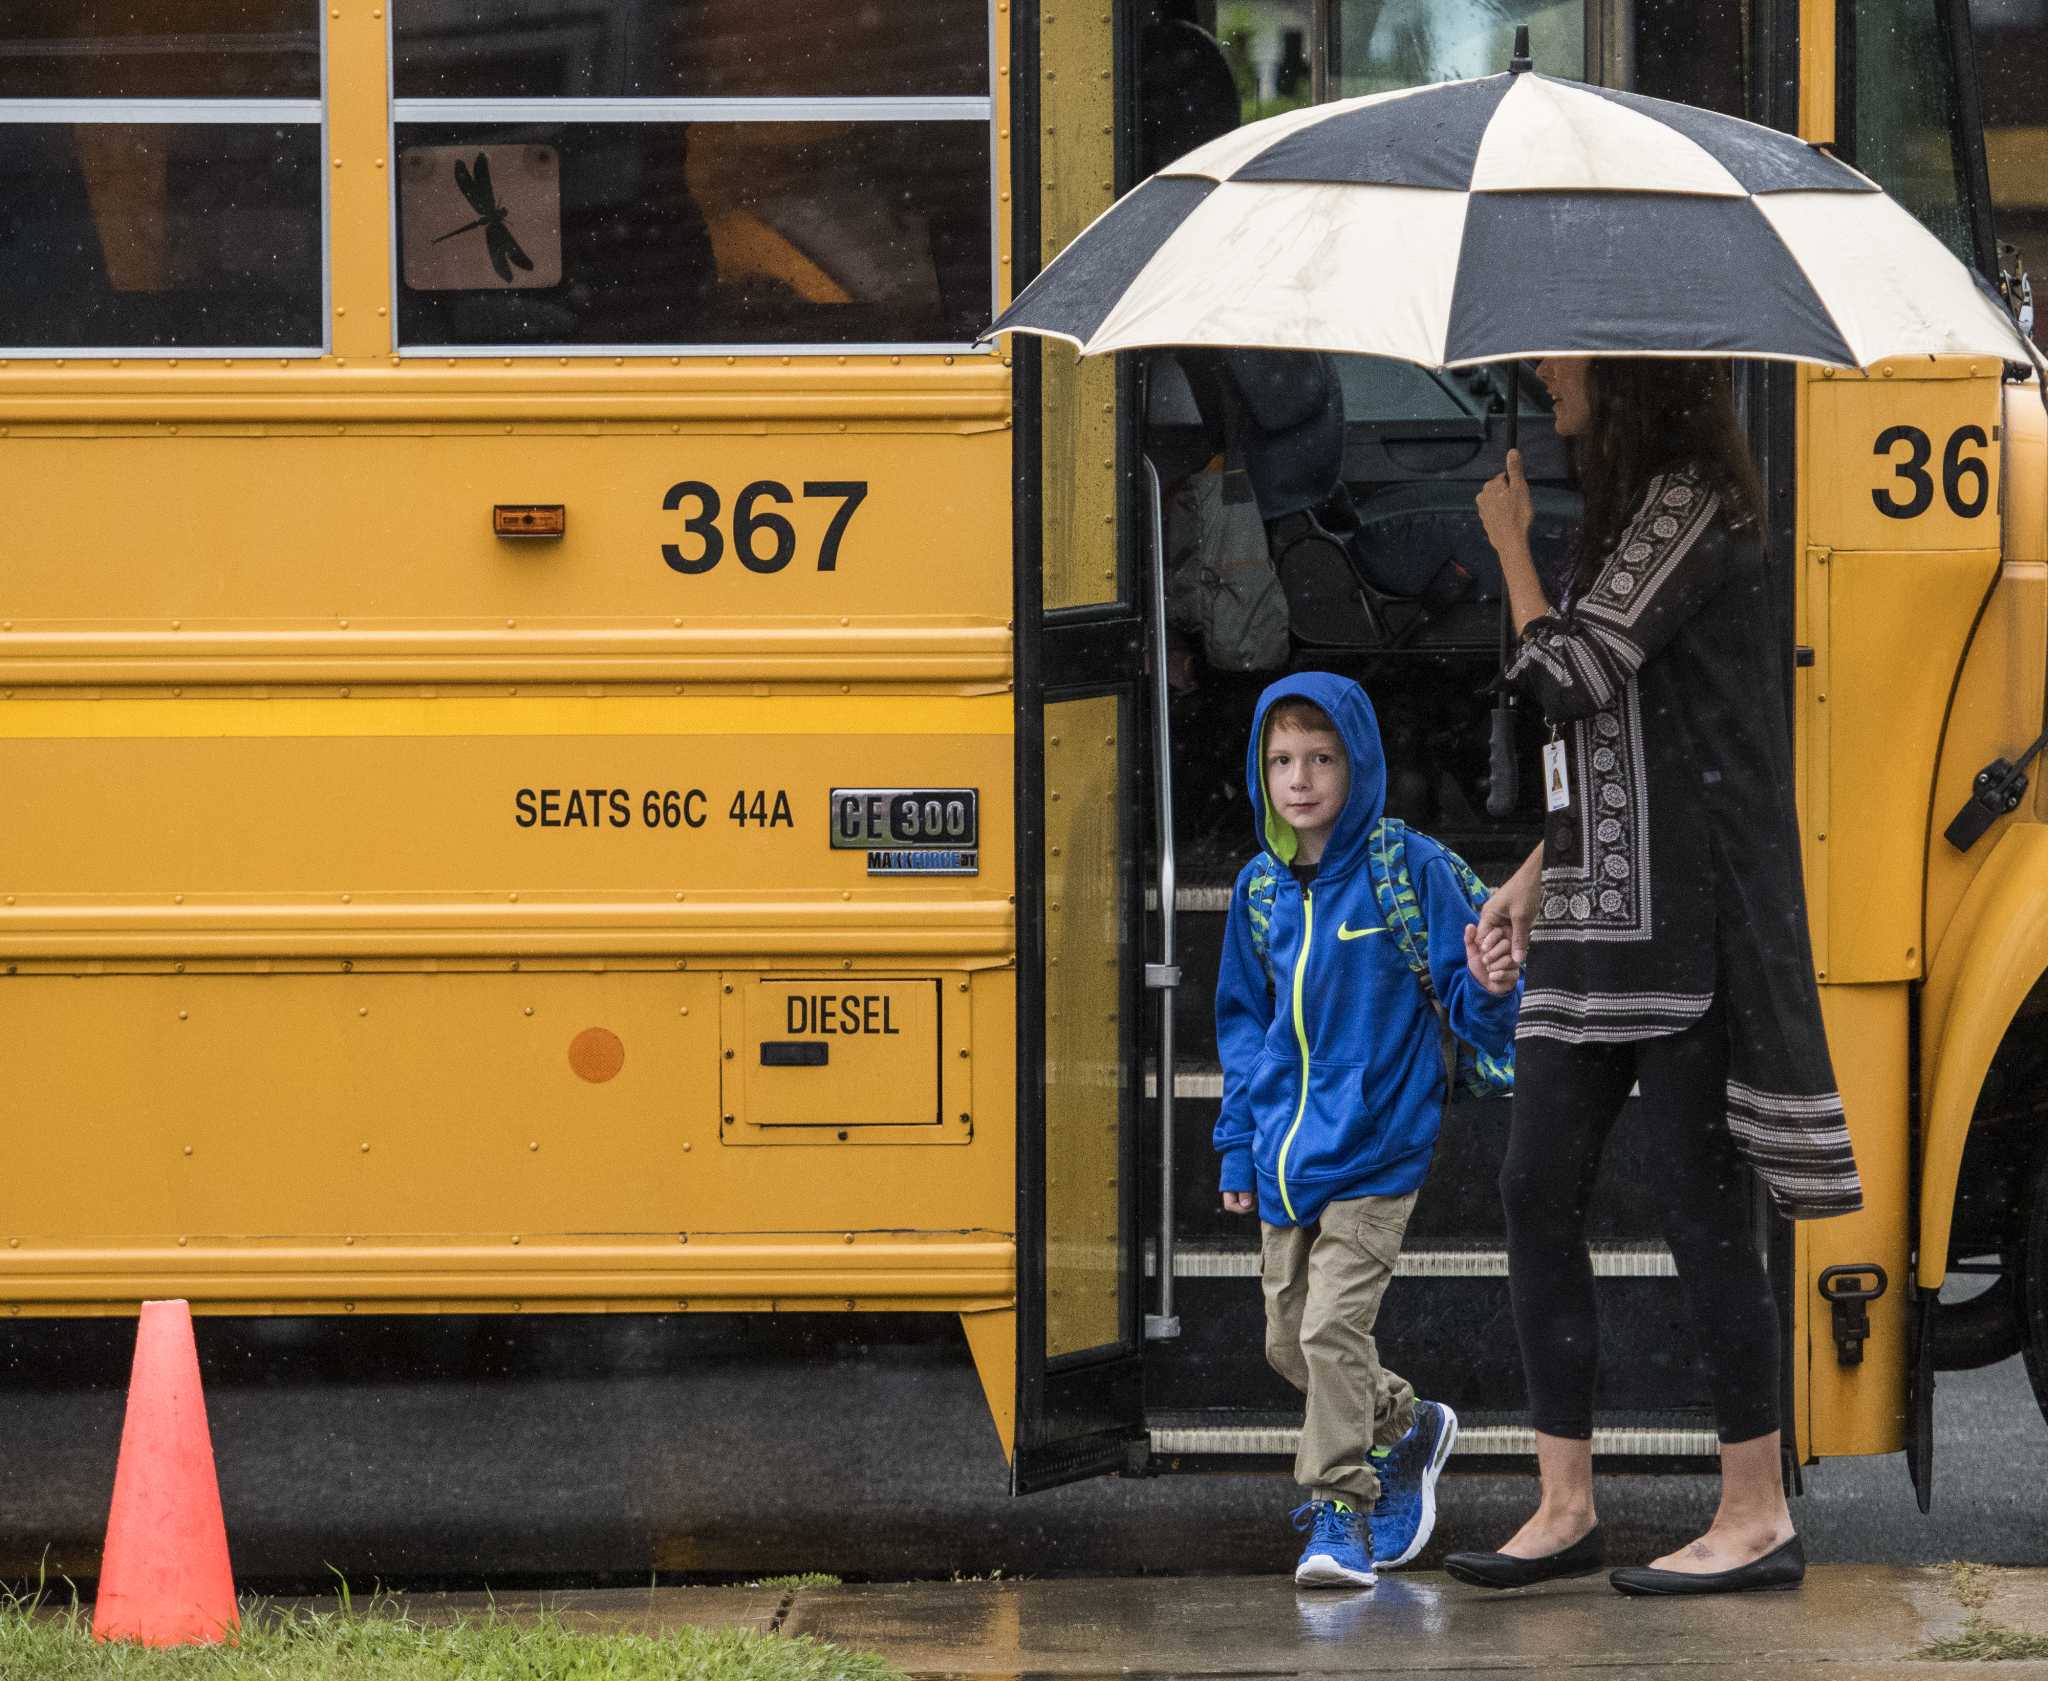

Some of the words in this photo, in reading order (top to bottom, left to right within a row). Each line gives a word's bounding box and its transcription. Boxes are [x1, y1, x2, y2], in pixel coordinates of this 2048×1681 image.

[1871, 424, 2001, 520] 36
[661, 480, 868, 575] 367
[515, 788, 631, 828] SEATS
[642, 788, 707, 829] 66C
[729, 789, 794, 828] 44A
[840, 797, 883, 839] CE
[901, 800, 965, 836] 300
[787, 994, 900, 1035] DIESEL
